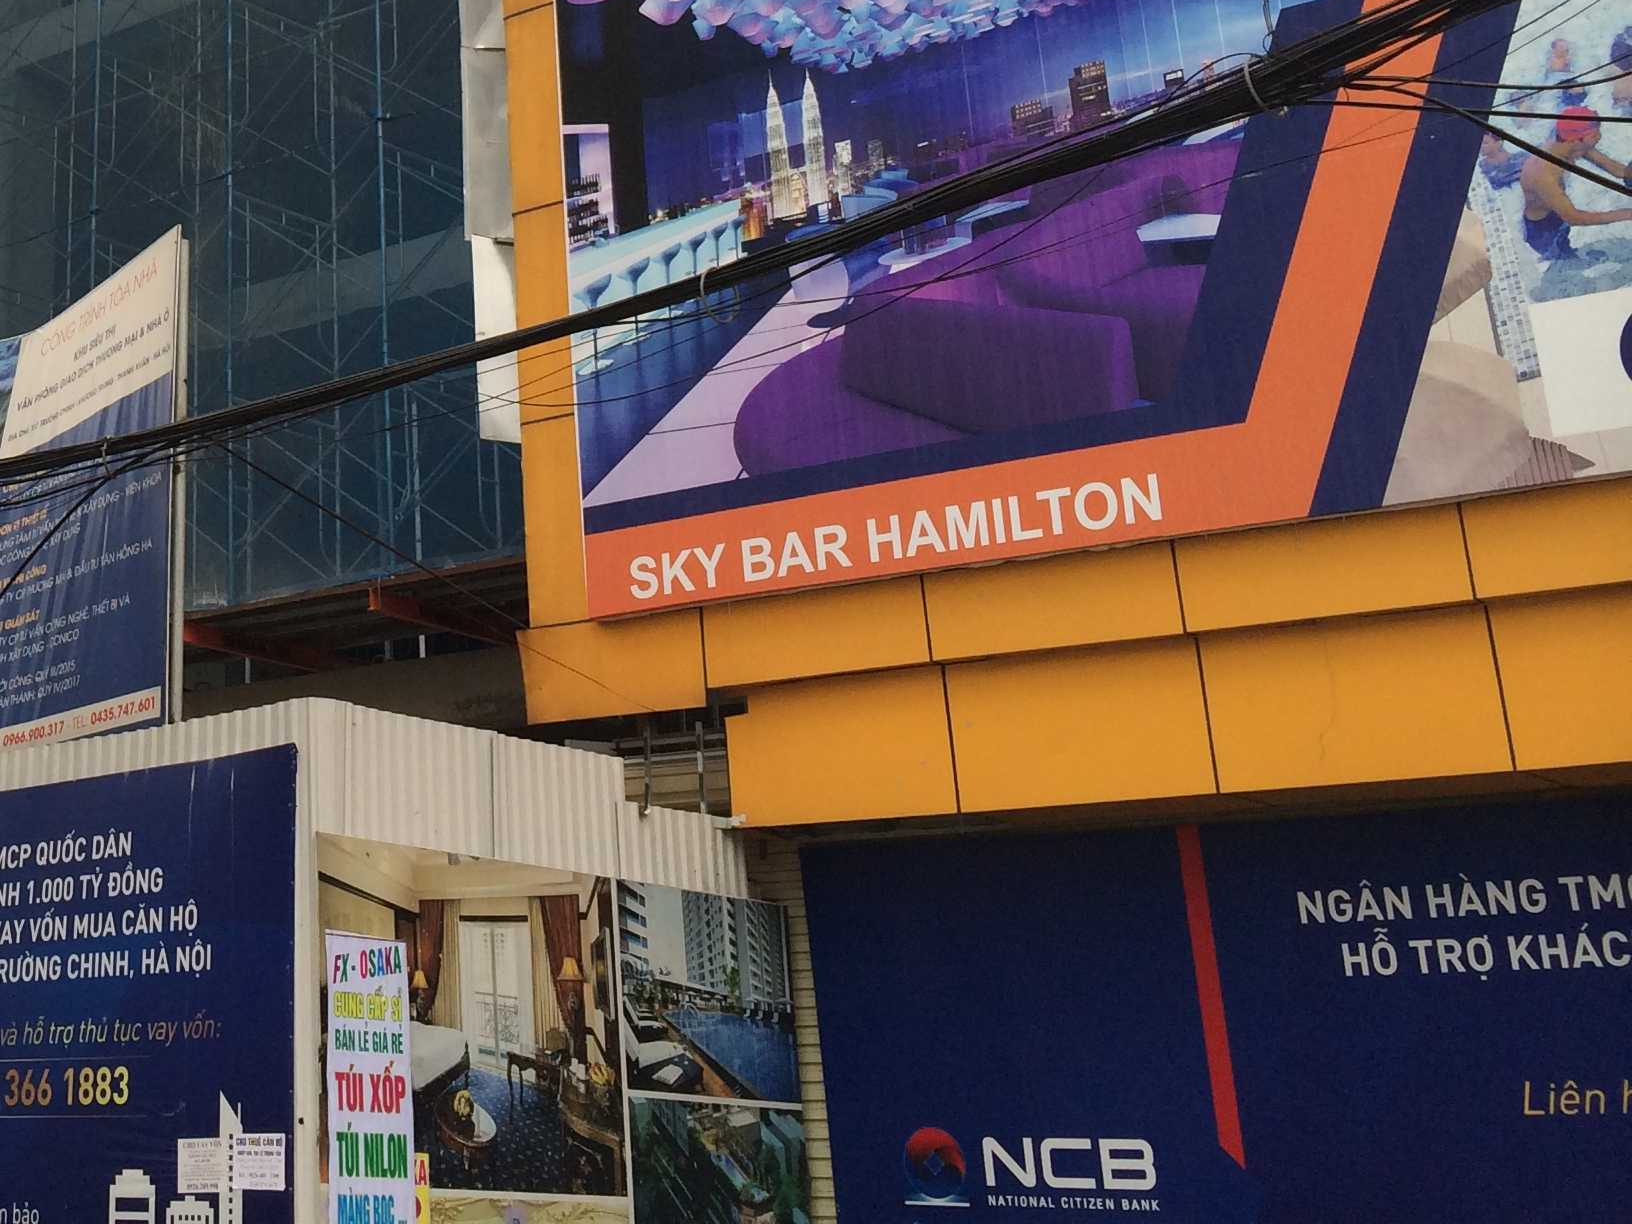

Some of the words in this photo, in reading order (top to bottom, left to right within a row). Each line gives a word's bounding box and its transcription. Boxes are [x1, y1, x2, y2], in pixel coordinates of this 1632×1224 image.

[629, 543, 725, 600] SKY
[741, 524, 852, 584] BAR
[867, 473, 1163, 564] HAMILTON
[2, 719, 66, 748] 0966.900.317
[90, 696, 156, 725] 0435.747.601
[36, 829, 87, 866] QUỐC
[92, 827, 133, 860] DÂN
[26, 876, 75, 904] 1.000
[79, 866, 103, 900] TỶ
[108, 861, 164, 898] ĐỒNG
[1296, 879, 1414, 925] NGÂN
[1424, 872, 1548, 918] HÀNG
[1557, 873, 1632, 912] TM
[29, 908, 68, 943] VỐN
[73, 912, 117, 940] MUA
[122, 903, 163, 936] CĂN
[169, 898, 198, 937] HỘ
[67, 950, 135, 980] CHINH,
[141, 941, 170, 975] HÀ
[175, 939, 212, 978] NỘI
[333, 953, 350, 984] FX
[359, 945, 402, 980] OSAKA
[1340, 926, 1399, 977] HỖ
[1407, 934, 1495, 982] TRỢ
[334, 990, 364, 1020] CUNG
[366, 985, 387, 1022] CẤP
[0, 1021, 18, 1046] và
[23, 1016, 46, 1046] hỗ
[49, 1021, 74, 1049] trợ
[79, 1016, 109, 1044] thủ
[113, 1019, 141, 1047] tục
[147, 1020, 179, 1047] vay
[182, 1009, 222, 1040] vốn:
[335, 1024, 355, 1052] BÁN
[358, 1021, 370, 1053] LẺ
[372, 1027, 389, 1055] GIÁ
[391, 1024, 404, 1055] RẺ
[4, 1068, 53, 1107] 366
[63, 1065, 130, 1106] 1883
[335, 1063, 365, 1113] TÚI
[370, 1060, 406, 1114] XỐP
[1523, 1079, 1606, 1116] Liên
[336, 1120, 360, 1178] TÚI
[363, 1132, 409, 1179] NILON
[982, 1136, 1157, 1191] NCB
[12, 1201, 40, 1224] bảo
[987, 1194, 1056, 1209] NATIONAL
[1061, 1197, 1115, 1211] CITIZEN
[1121, 1198, 1161, 1212] BANK
